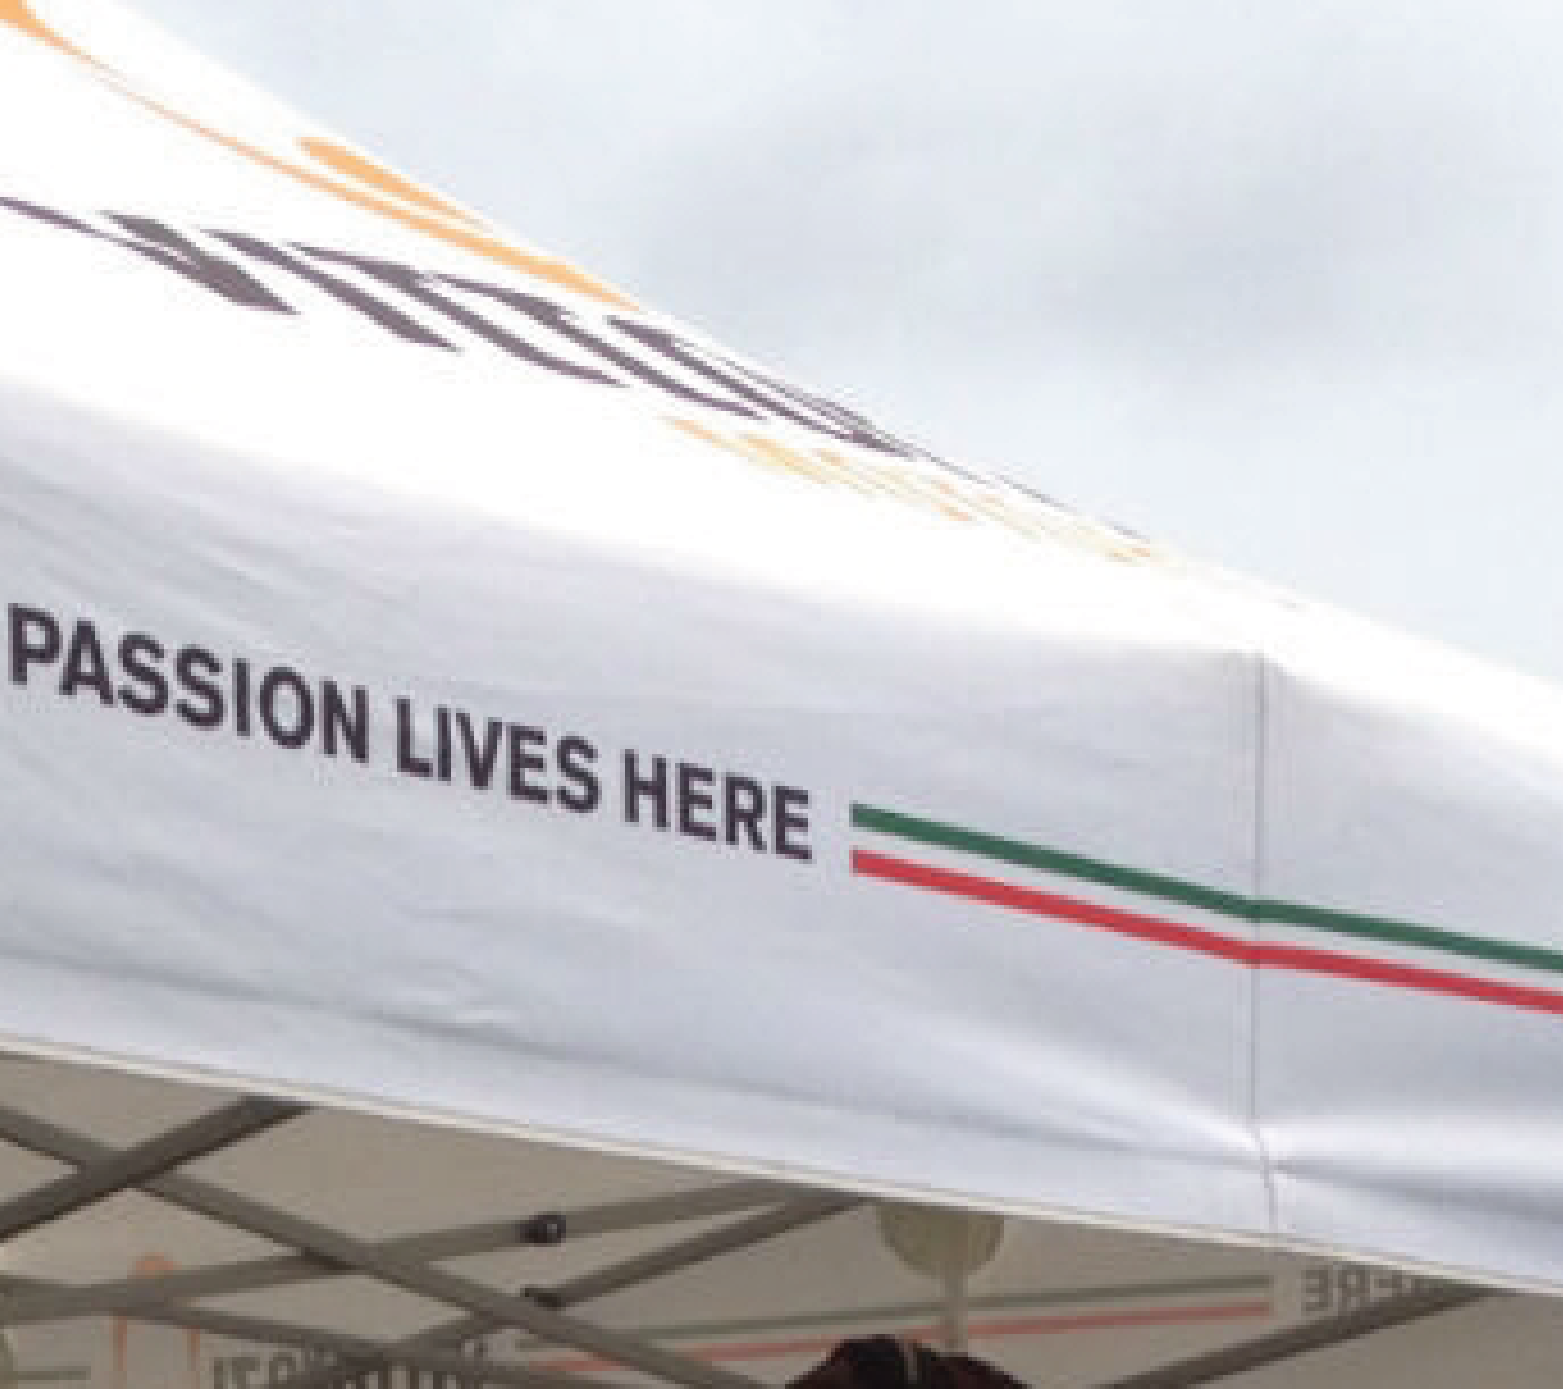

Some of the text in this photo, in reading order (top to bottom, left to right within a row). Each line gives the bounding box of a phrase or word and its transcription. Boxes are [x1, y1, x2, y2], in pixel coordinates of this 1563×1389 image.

[6, 601, 813, 862] PASSION LIVES HERE
